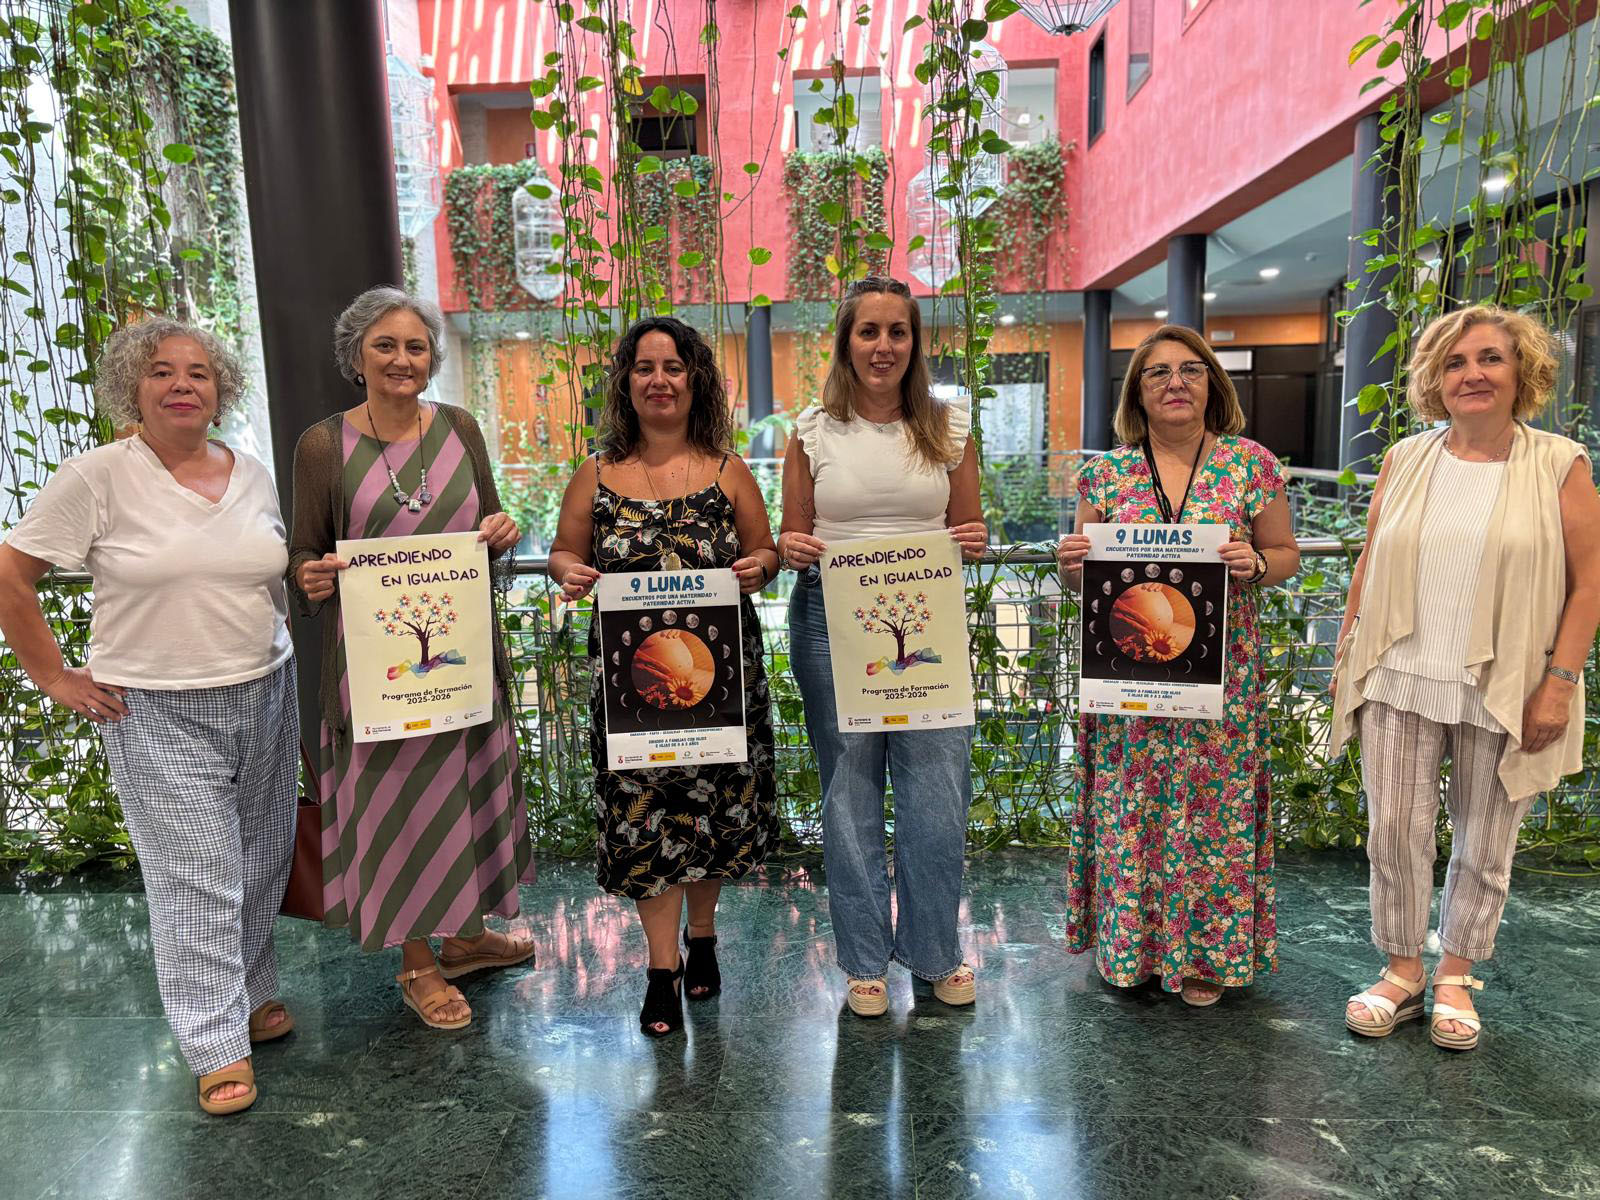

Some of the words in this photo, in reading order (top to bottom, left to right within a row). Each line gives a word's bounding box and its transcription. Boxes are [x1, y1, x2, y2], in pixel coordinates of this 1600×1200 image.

[1116, 529, 1126, 544] 9
[1132, 529, 1193, 545] LUNAS
[349, 549, 452, 568] APRENDIENDO
[829, 548, 926, 569] APRENDIENDO
[381, 575, 402, 587] EN
[407, 568, 479, 586] IGUALDAD
[630, 577, 641, 593] 9
[647, 575, 705, 593] LUNAS
[860, 575, 879, 587] EN
[884, 566, 952, 585] IGUALDAD
[382, 692, 422, 702] Programa
[434, 683, 473, 694] Formación
[862, 688, 899, 696] Programa
[910, 683, 950, 692] Formación
[885, 691, 928, 700] 2025-2026
[407, 693, 451, 705] 2025-2026
